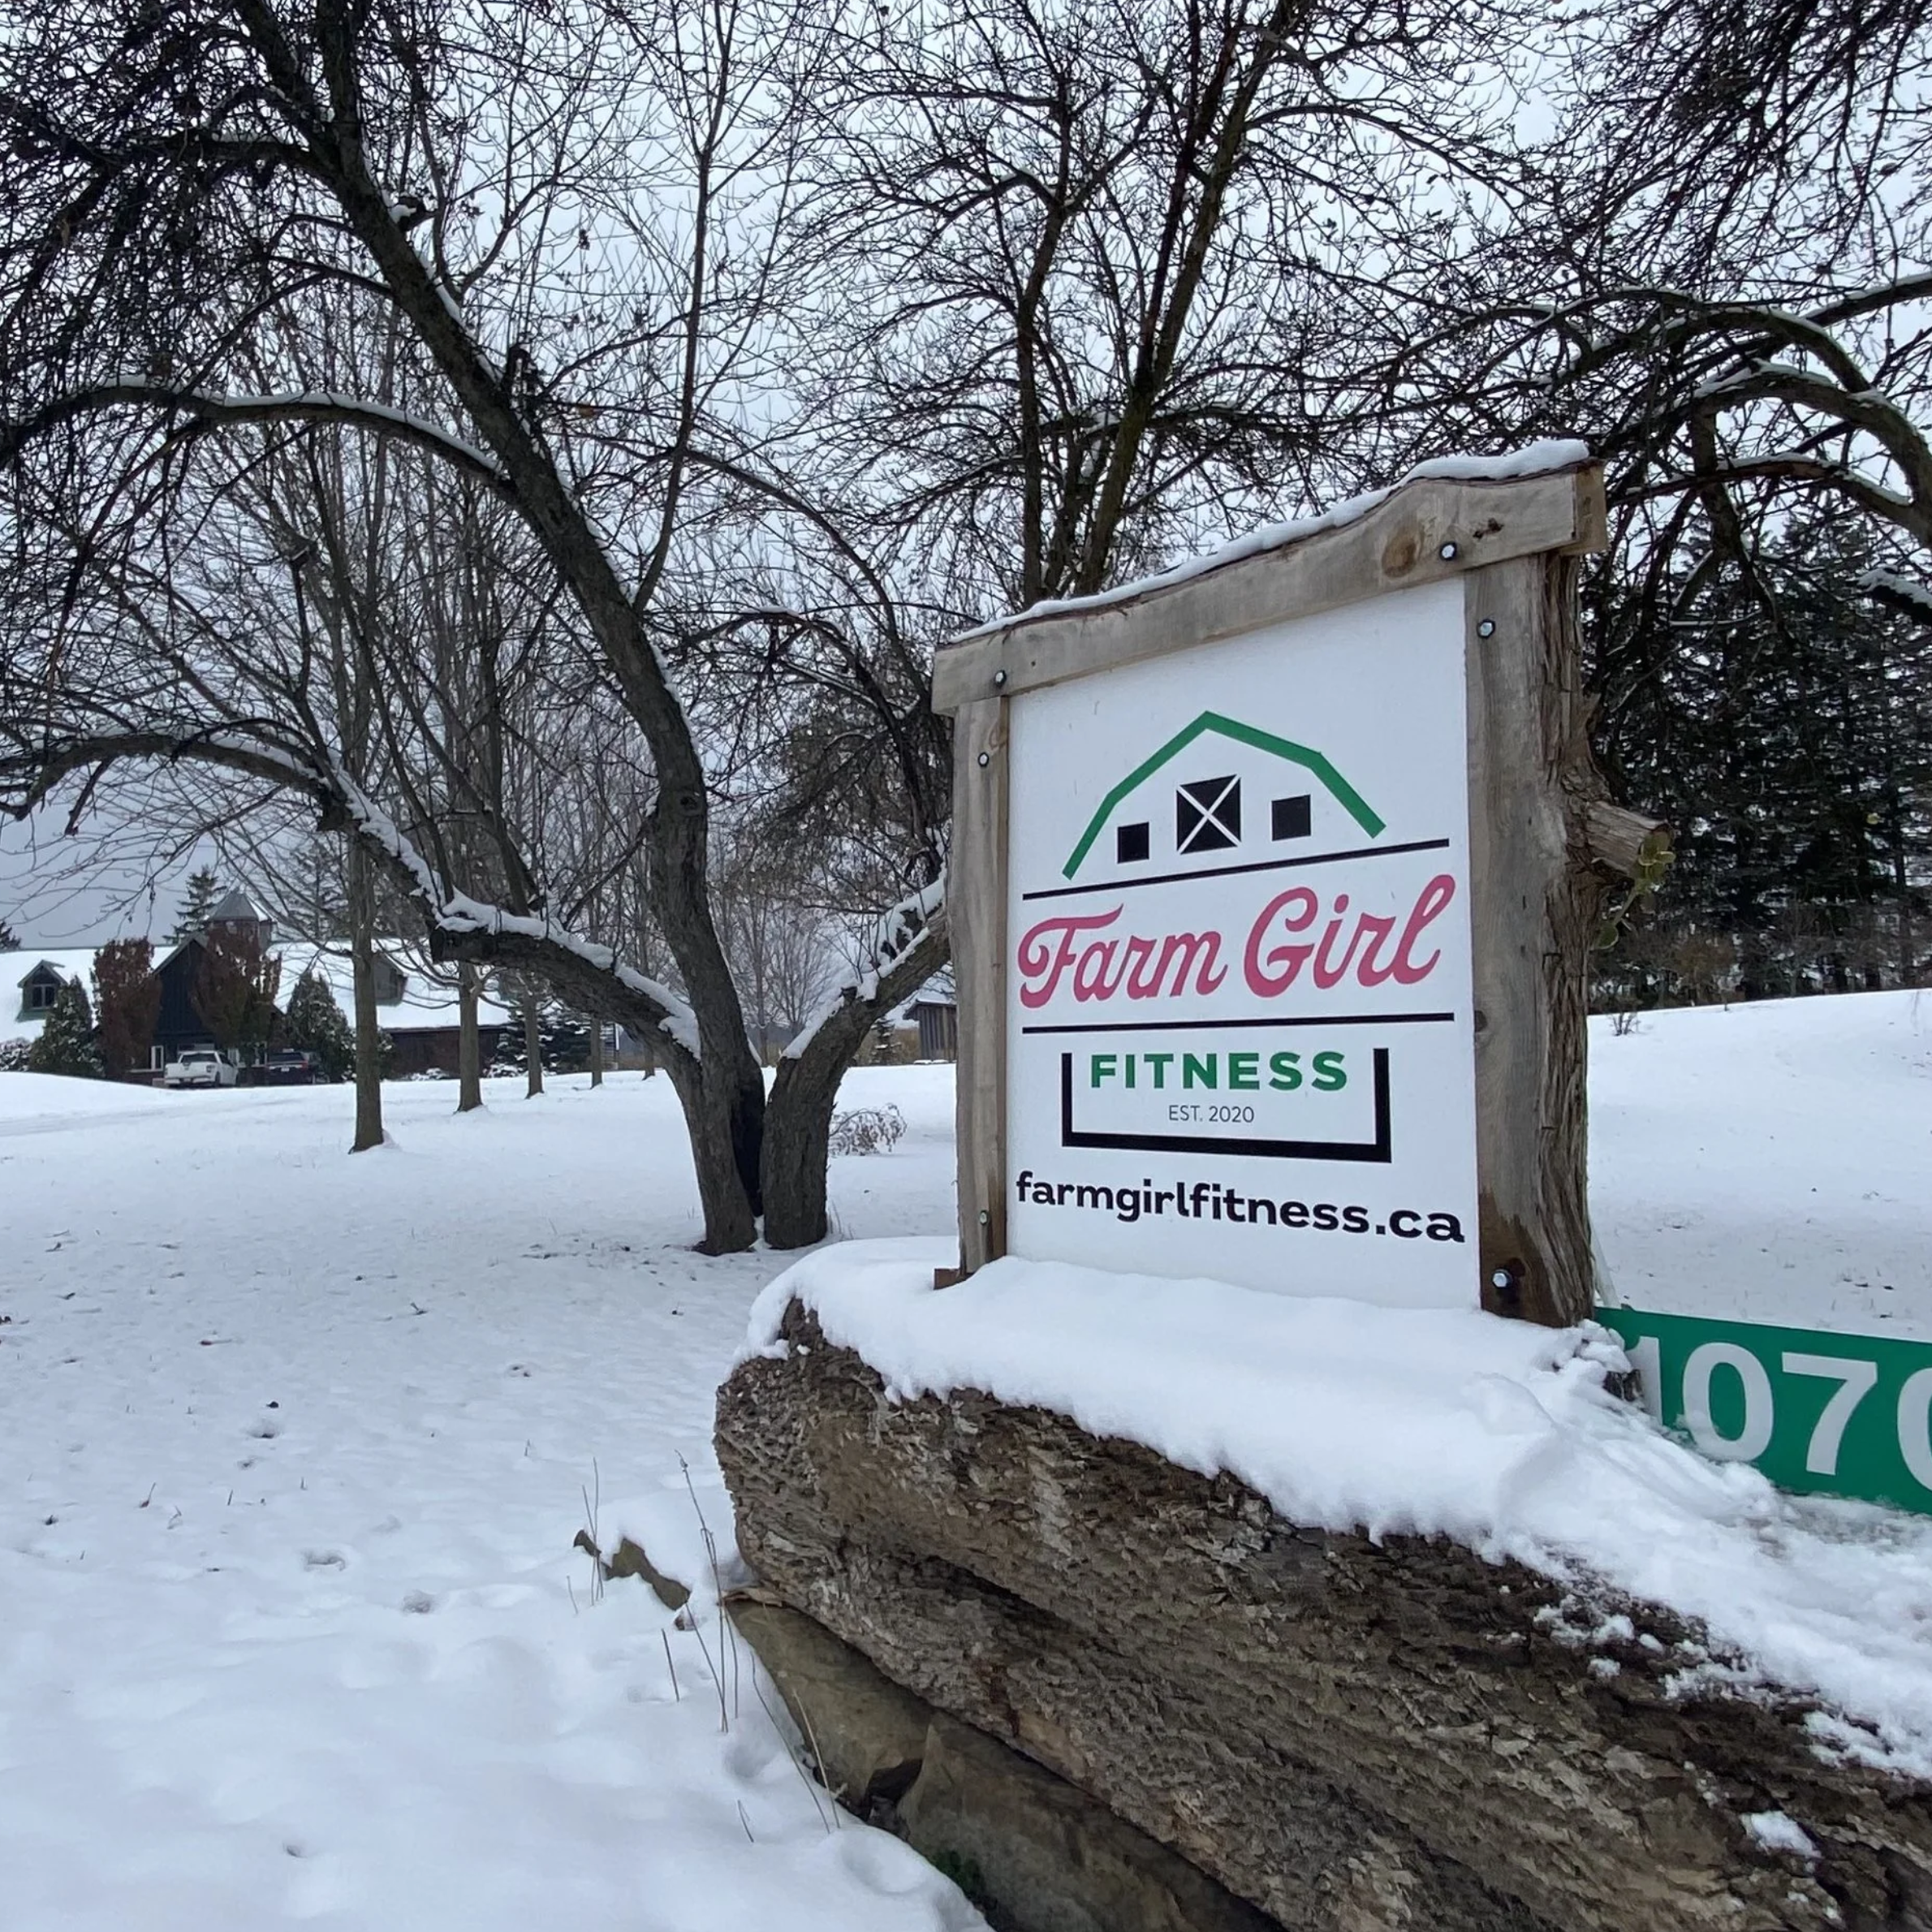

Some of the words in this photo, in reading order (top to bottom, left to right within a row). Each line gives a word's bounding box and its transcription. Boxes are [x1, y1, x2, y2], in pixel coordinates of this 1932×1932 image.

[1018, 903, 1227, 1008] Farm
[1244, 874, 1455, 998] Girl
[1090, 1051, 1348, 1090] FITNESS
[1168, 1106, 1203, 1122] EST.
[1208, 1106, 1255, 1123] 2020
[1016, 1171, 1465, 1242] farmgirlfitness.ca
